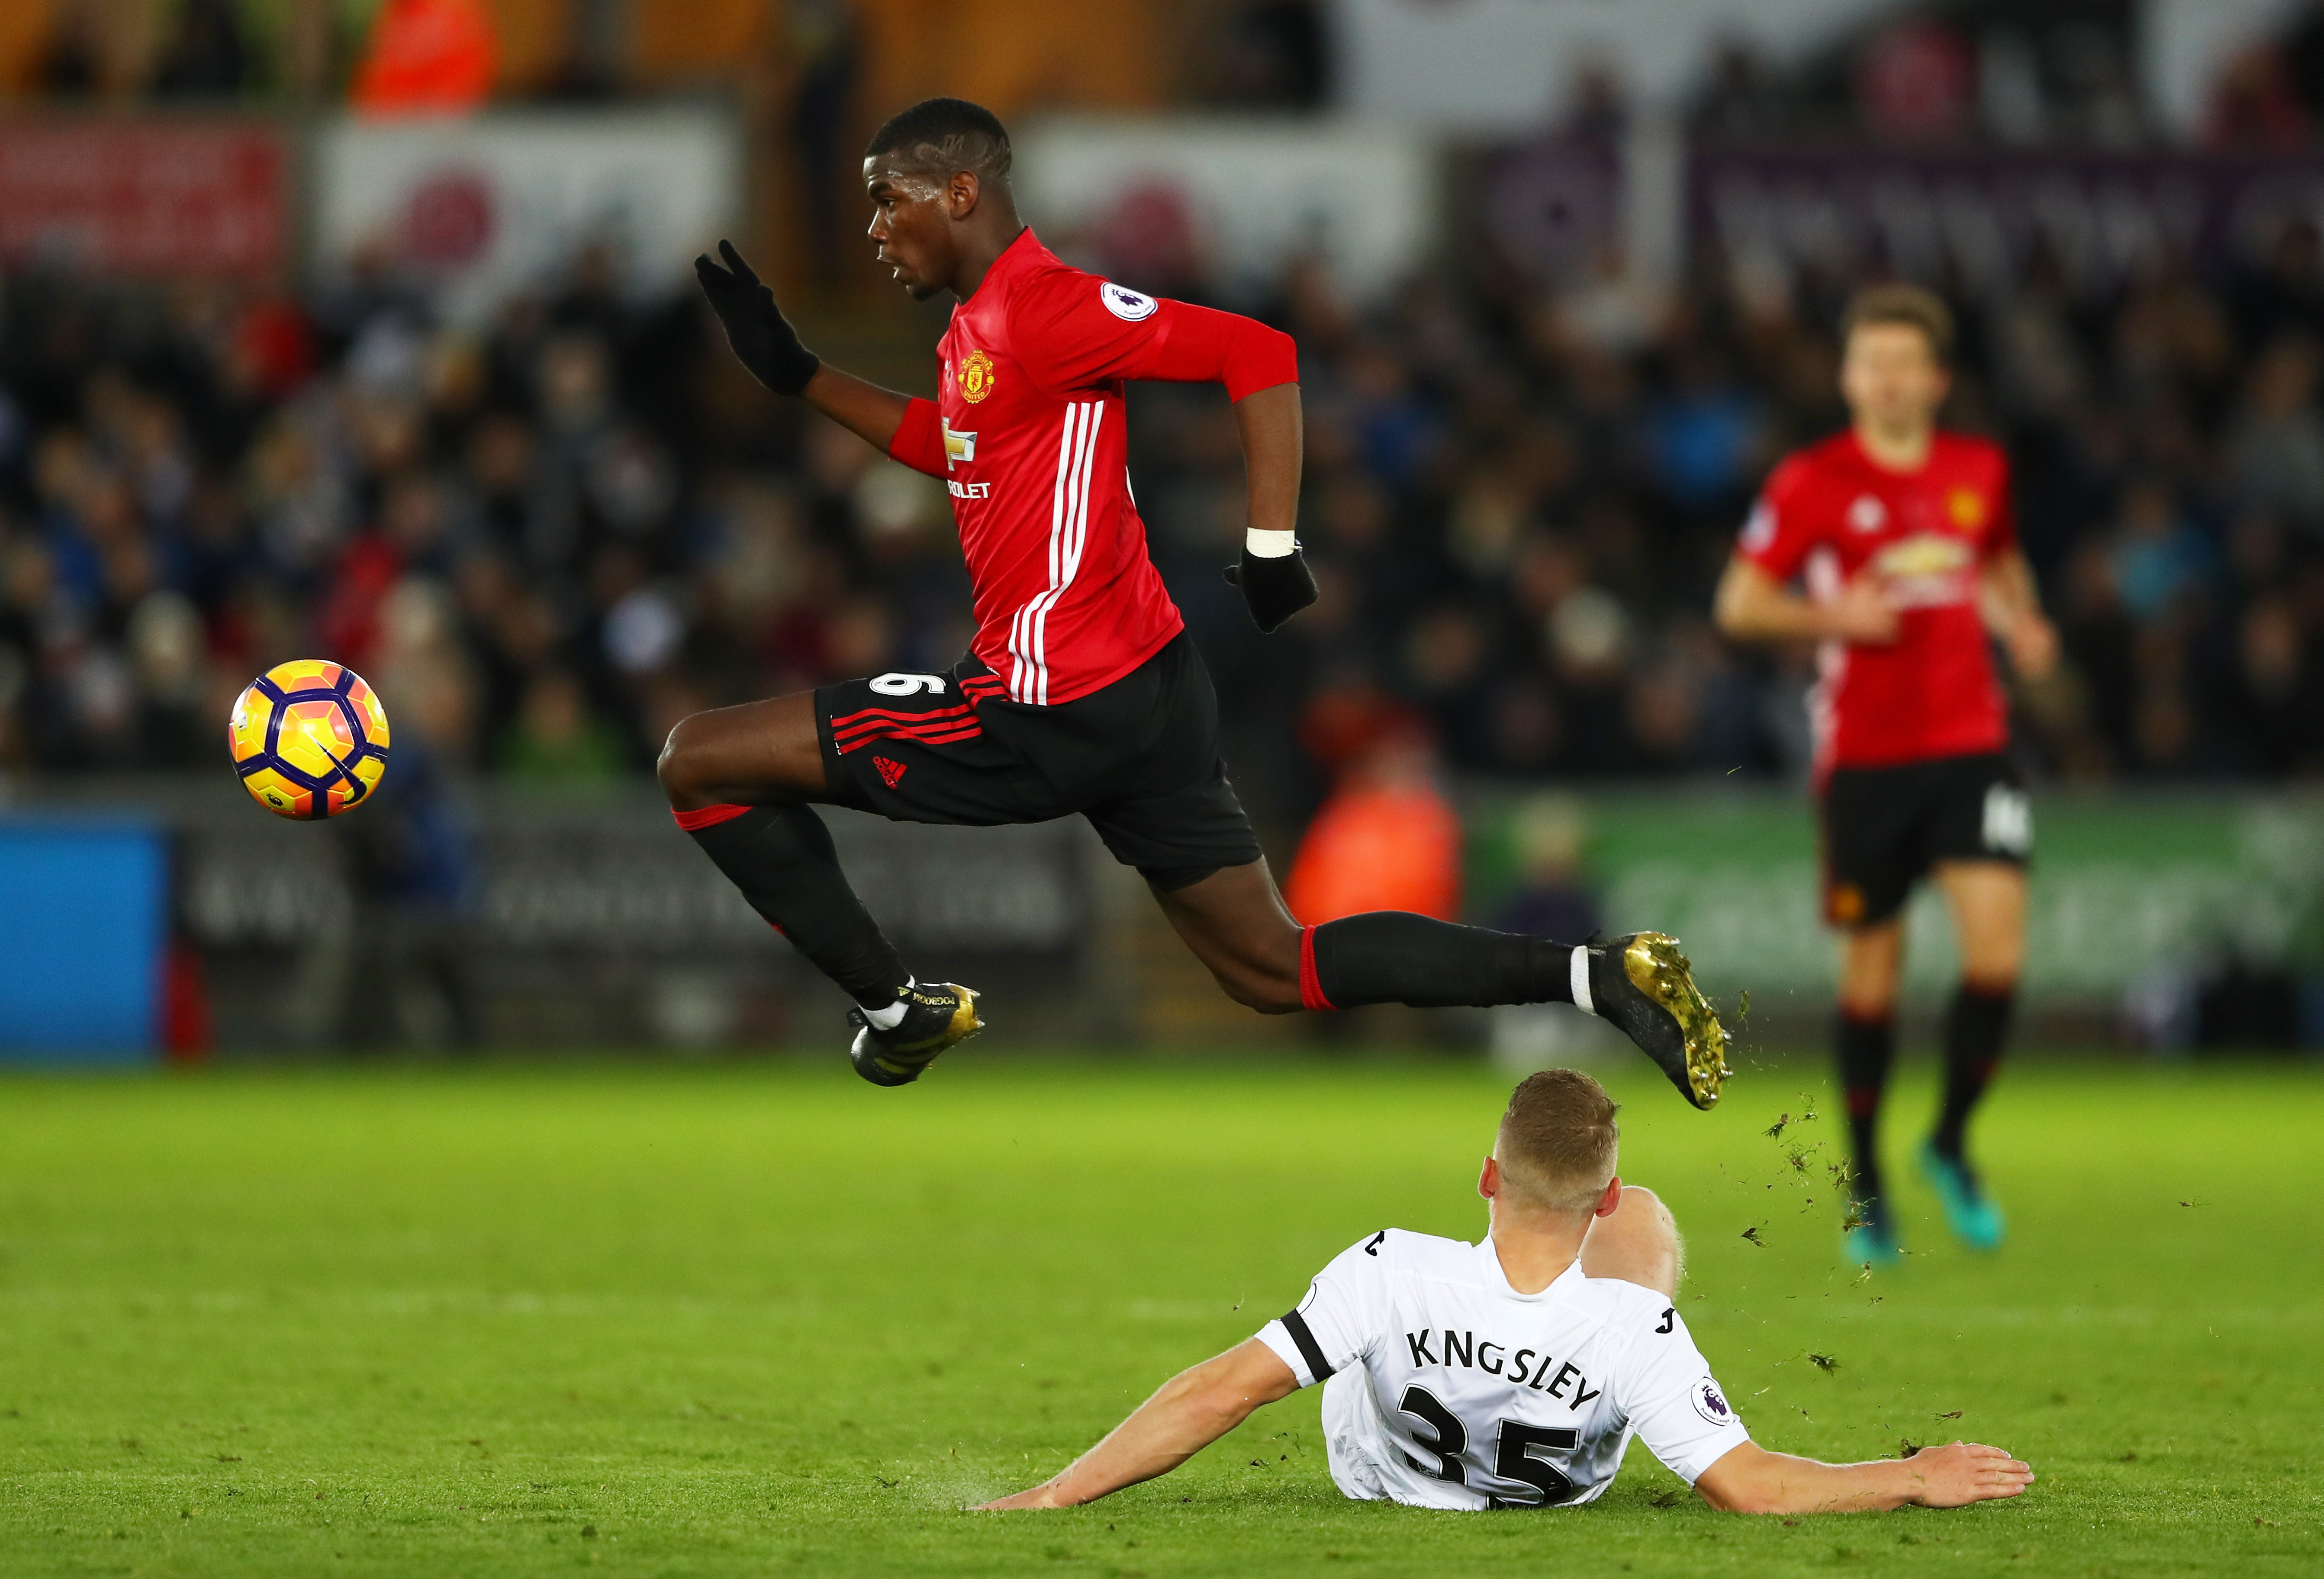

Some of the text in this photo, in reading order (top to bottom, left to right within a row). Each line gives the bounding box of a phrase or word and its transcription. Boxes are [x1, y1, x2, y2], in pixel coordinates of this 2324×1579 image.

[963, 354, 991, 371] MANCHESTER
[964, 390, 985, 400] UNITED
[872, 756, 898, 790] adidas
[913, 992, 956, 1005] POGBOOM
[1397, 1383, 1580, 1510] 35
